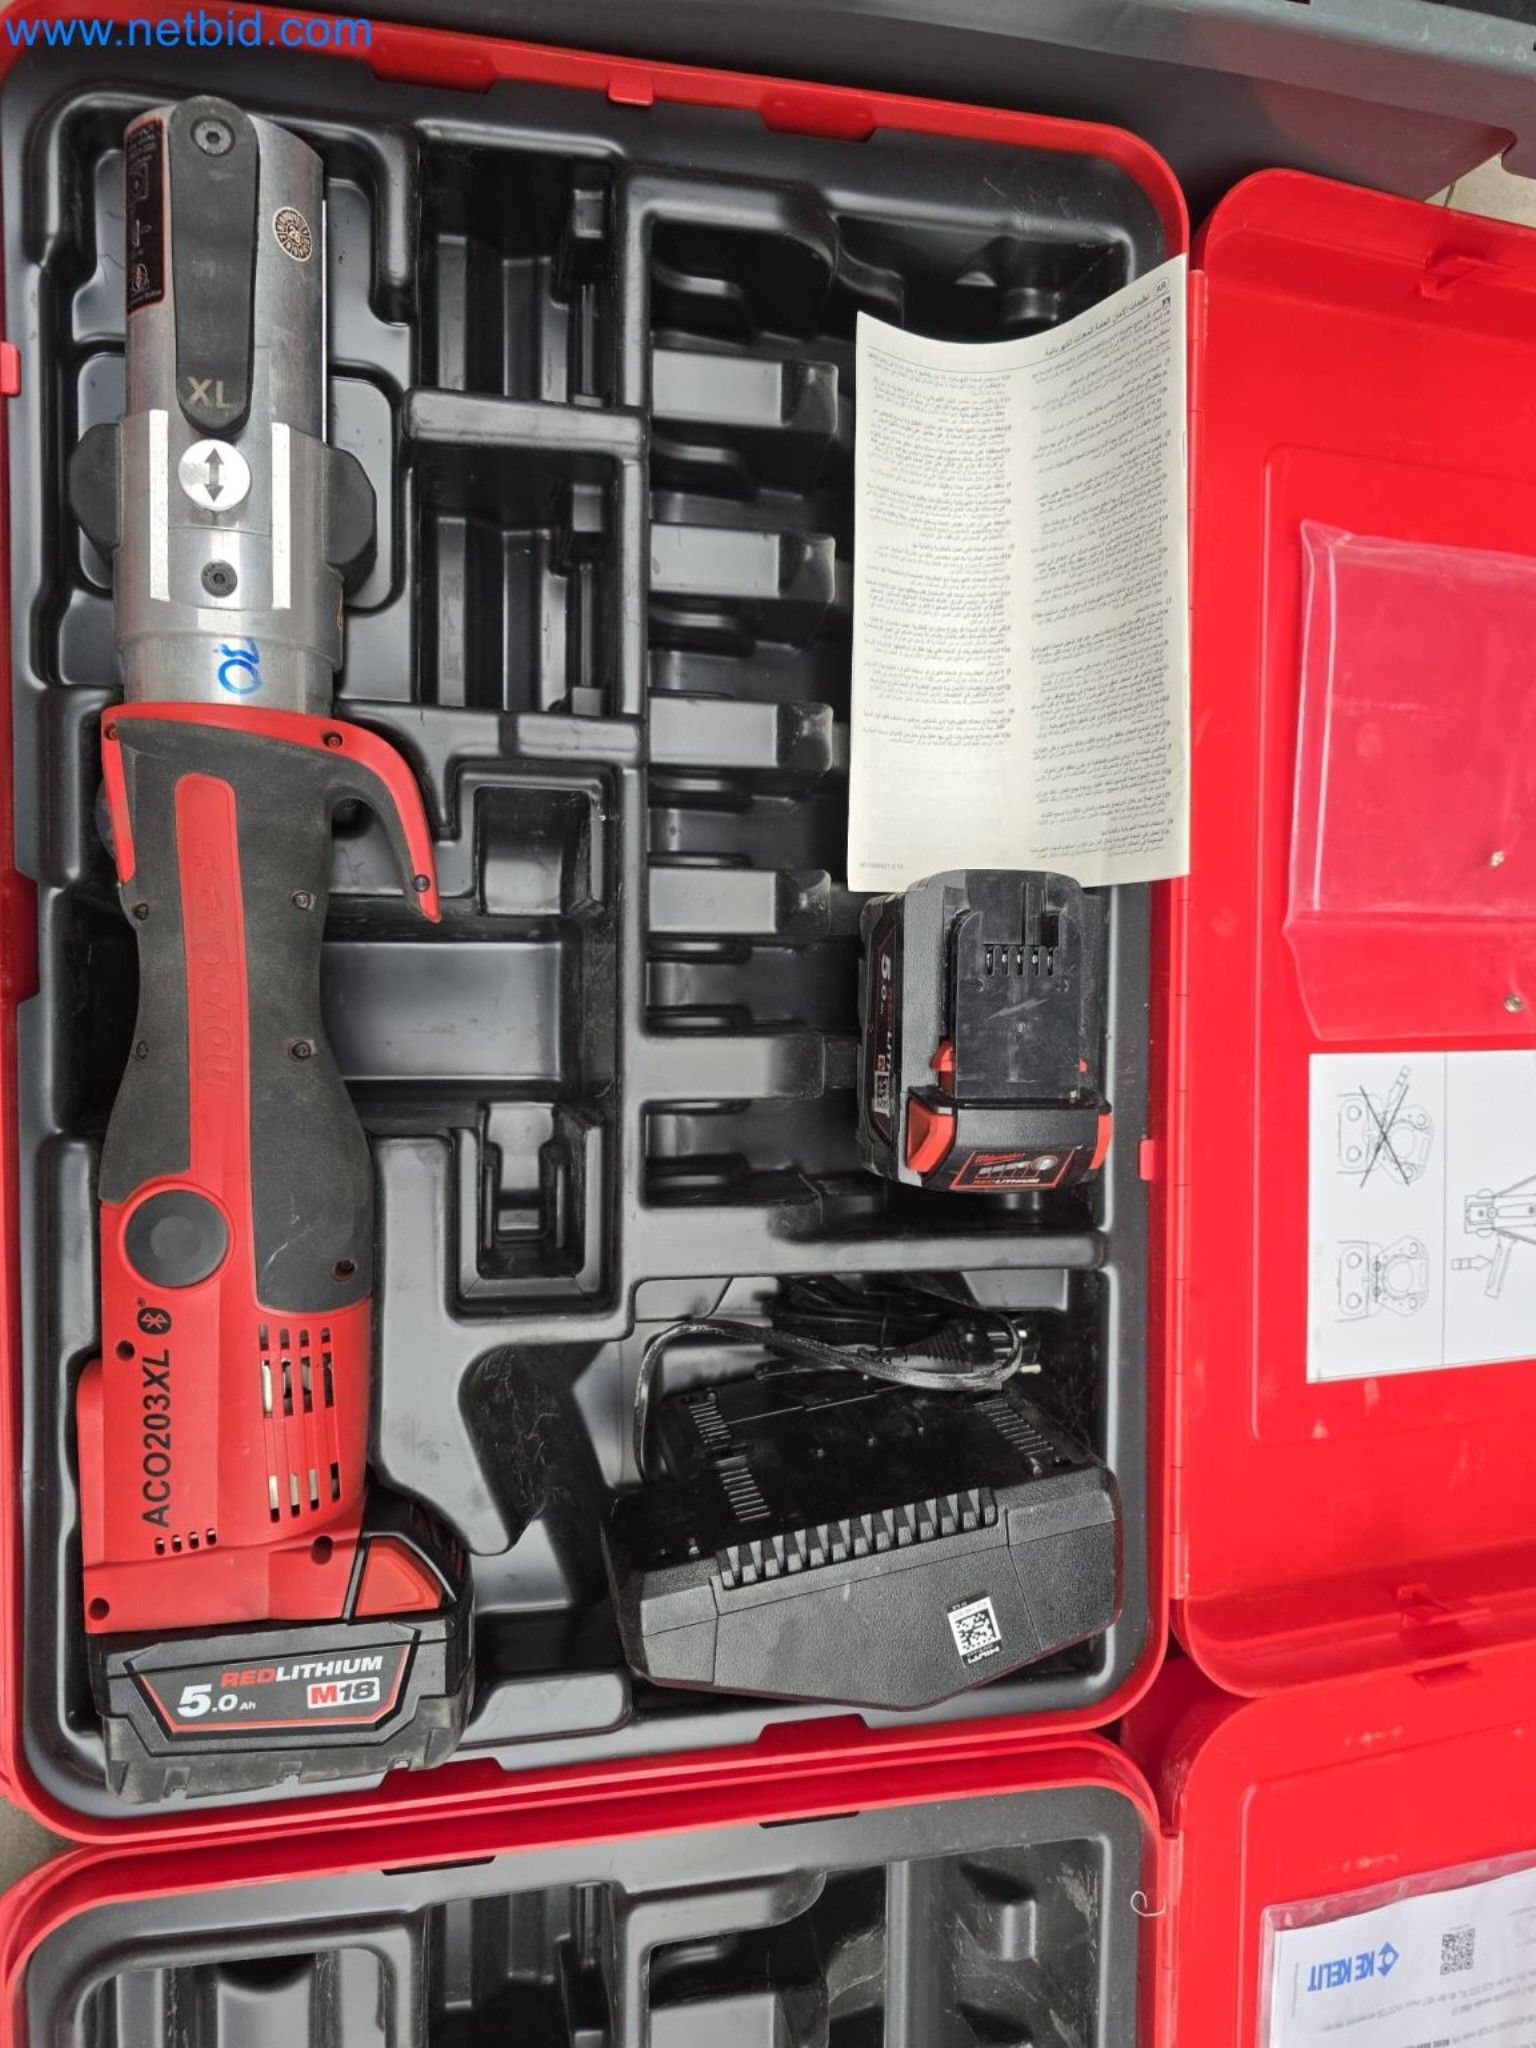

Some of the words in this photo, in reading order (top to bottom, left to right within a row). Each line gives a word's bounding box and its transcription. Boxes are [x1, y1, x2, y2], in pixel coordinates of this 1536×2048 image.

[187, 376, 232, 410] XL
[141, 1349, 172, 1528] ACO203XL
[220, 1655, 383, 1689] REDLITHIUM
[239, 1700, 257, 1711] Ah
[310, 1680, 378, 1706] M18
[1307, 1956, 1353, 1993] KELIT
[1355, 1950, 1376, 1981] KE
